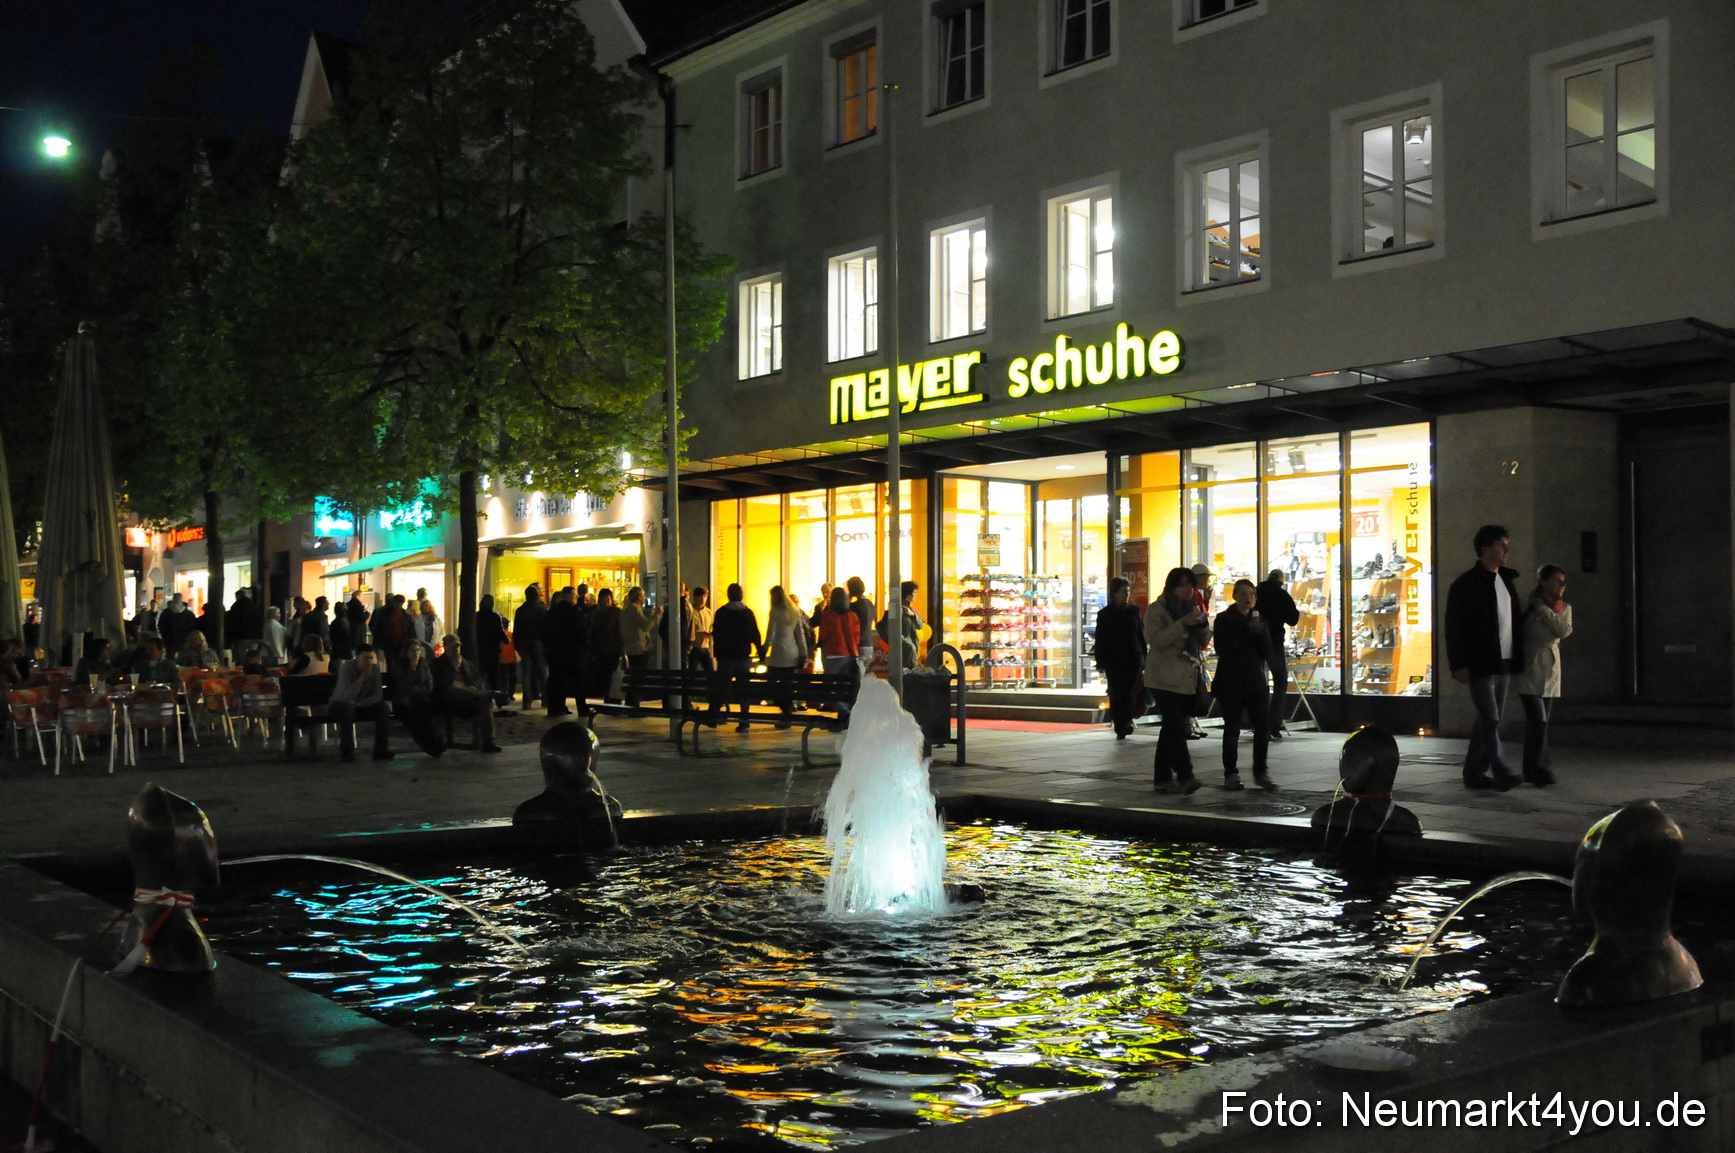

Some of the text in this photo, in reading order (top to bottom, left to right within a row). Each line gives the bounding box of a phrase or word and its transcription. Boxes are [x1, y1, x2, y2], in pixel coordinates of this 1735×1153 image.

[829, 322, 1181, 425] mayer schuhe
[1355, 516, 1375, 533] 20
[1405, 462, 1423, 625] mayer schuhe
